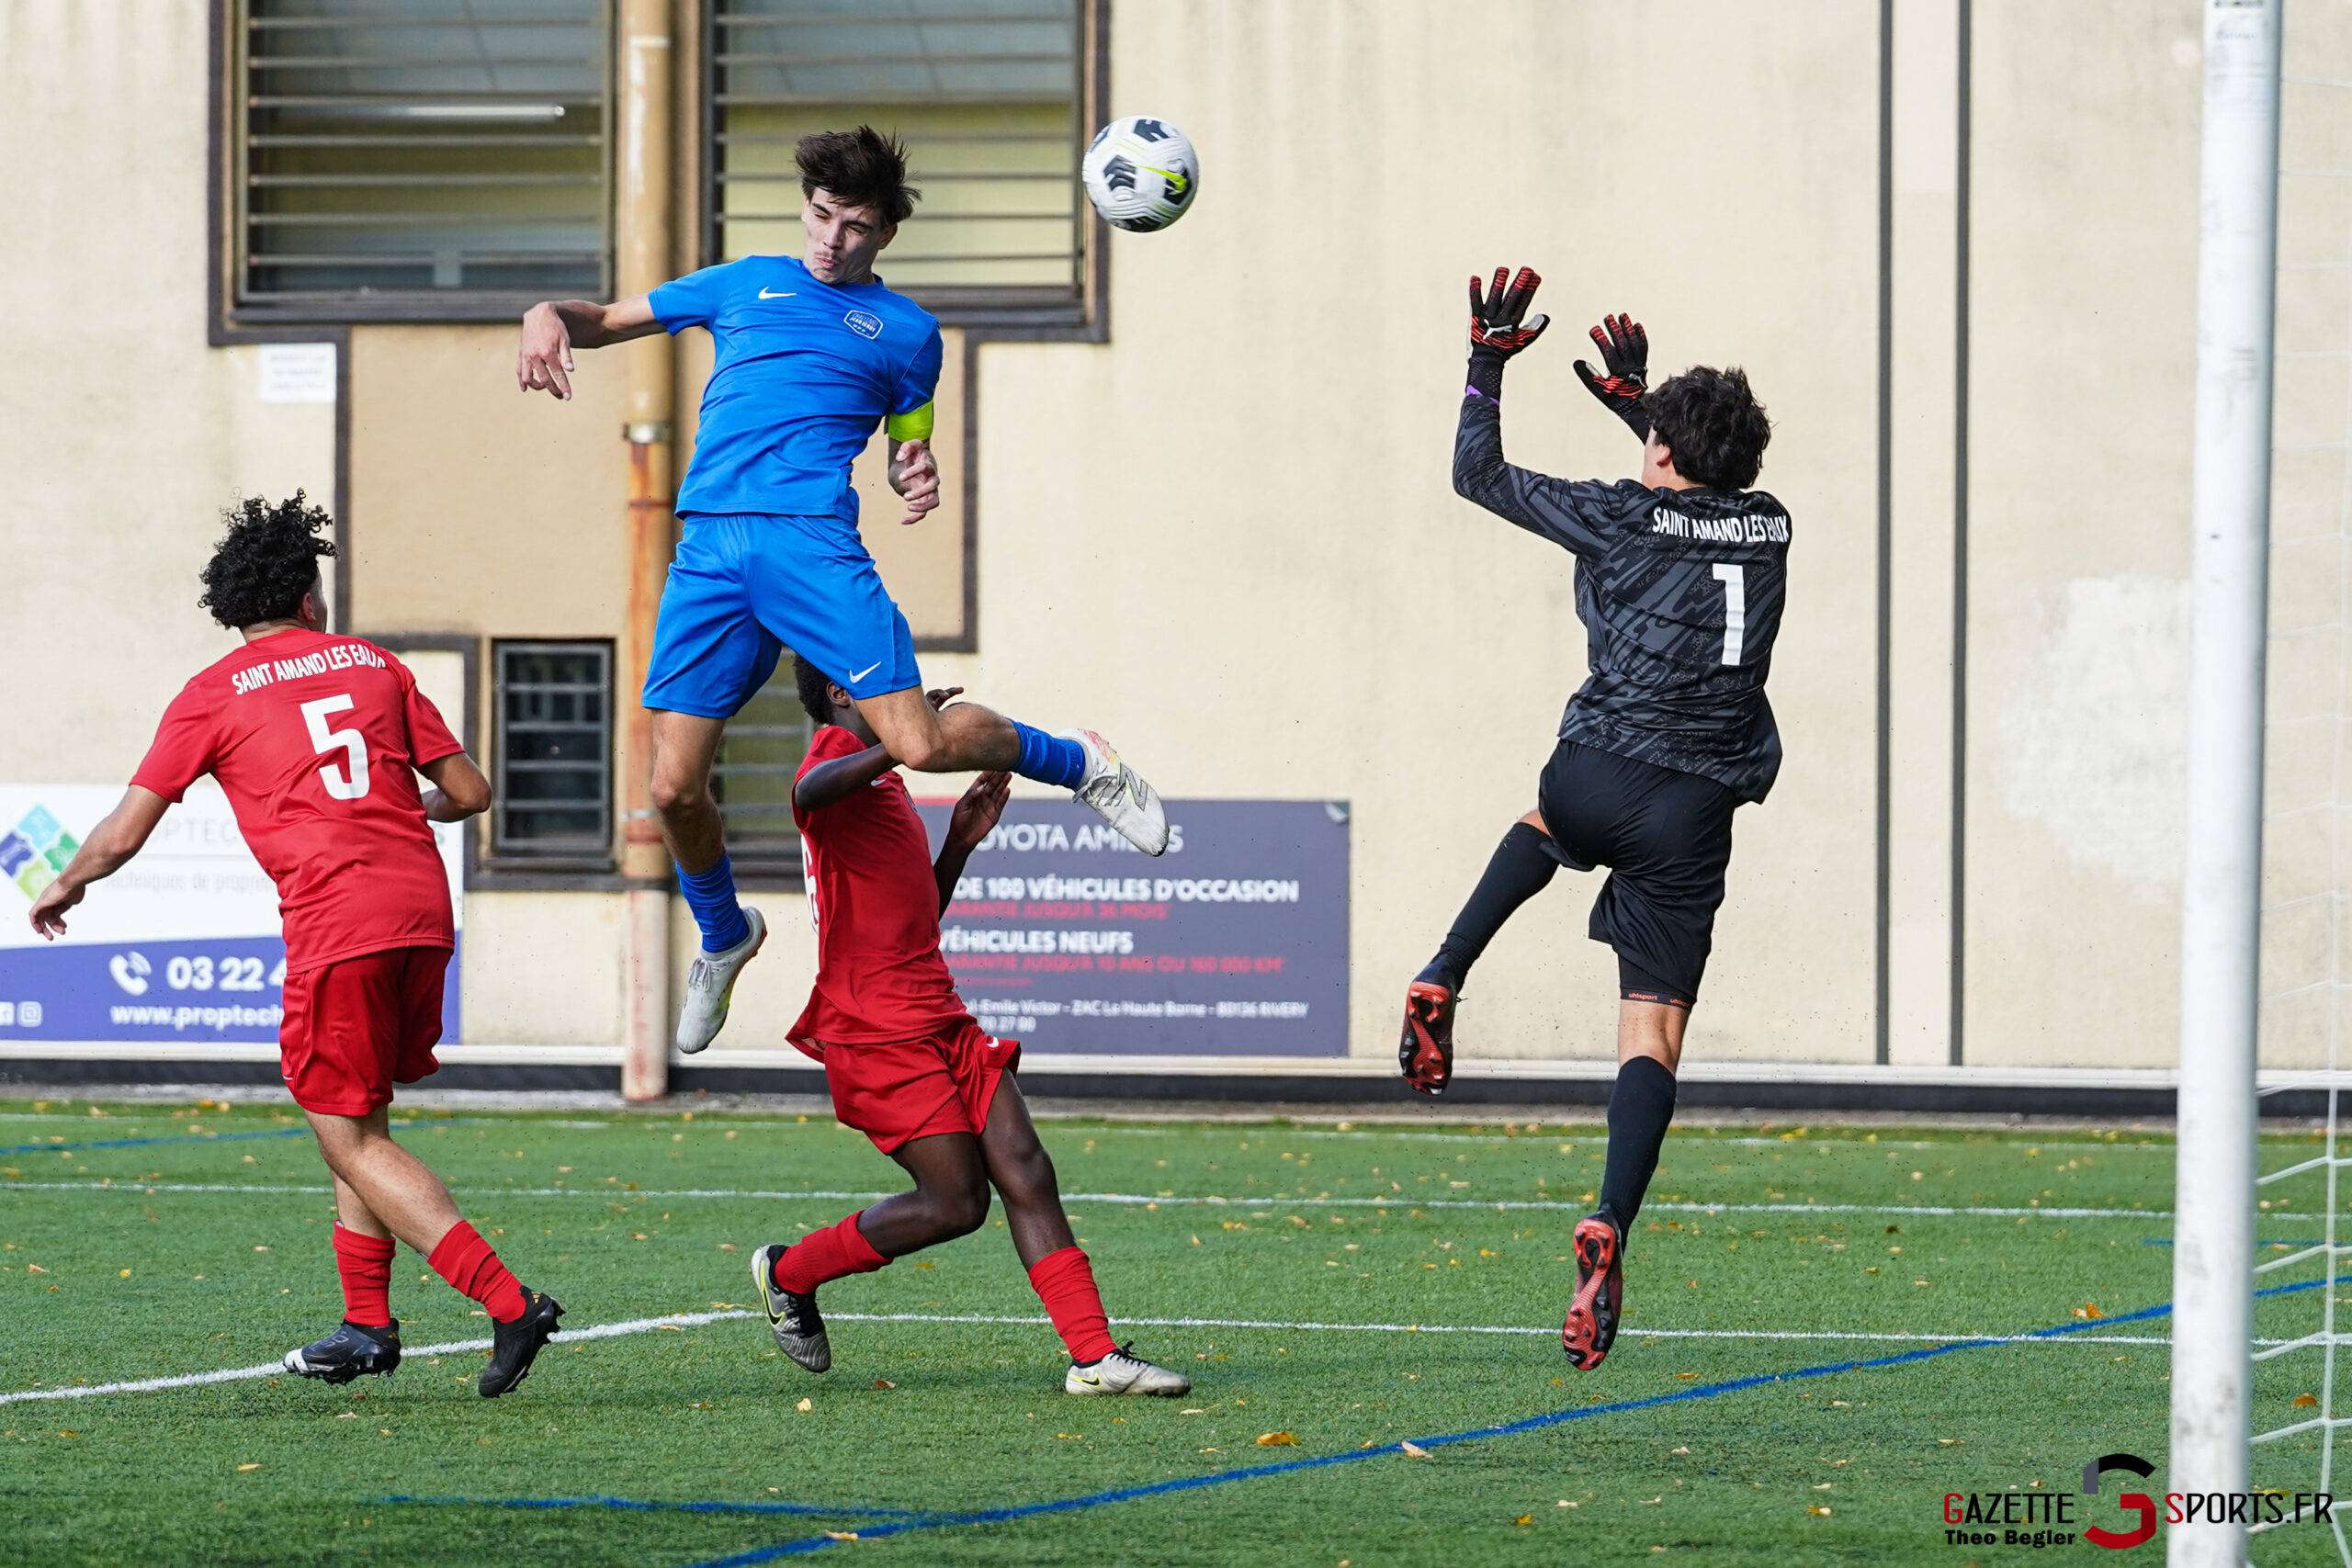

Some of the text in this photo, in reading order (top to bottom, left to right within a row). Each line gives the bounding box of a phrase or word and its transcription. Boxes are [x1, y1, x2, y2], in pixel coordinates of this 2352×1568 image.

[1652, 506, 1790, 543] SAINT AMAND LES EAUX
[1713, 563, 1745, 666] 1
[232, 663, 274, 695] SAINT
[274, 652, 327, 682] AMAND
[323, 645, 353, 670] LES
[300, 693, 370, 800] 5
[151, 818, 240, 844] PTEC
[975, 823, 1183, 852] OYOTA AMIS
[986, 877, 1025, 900] 100
[1026, 873, 1152, 901] VÉHICULES
[1153, 878, 1300, 903] D'OCCASION
[1058, 931, 1134, 954] NEUFS
[166, 955, 215, 991] 03
[219, 956, 266, 992] 22
[1157, 955, 1185, 973] OU
[1628, 992, 1657, 1000] uhlsport
